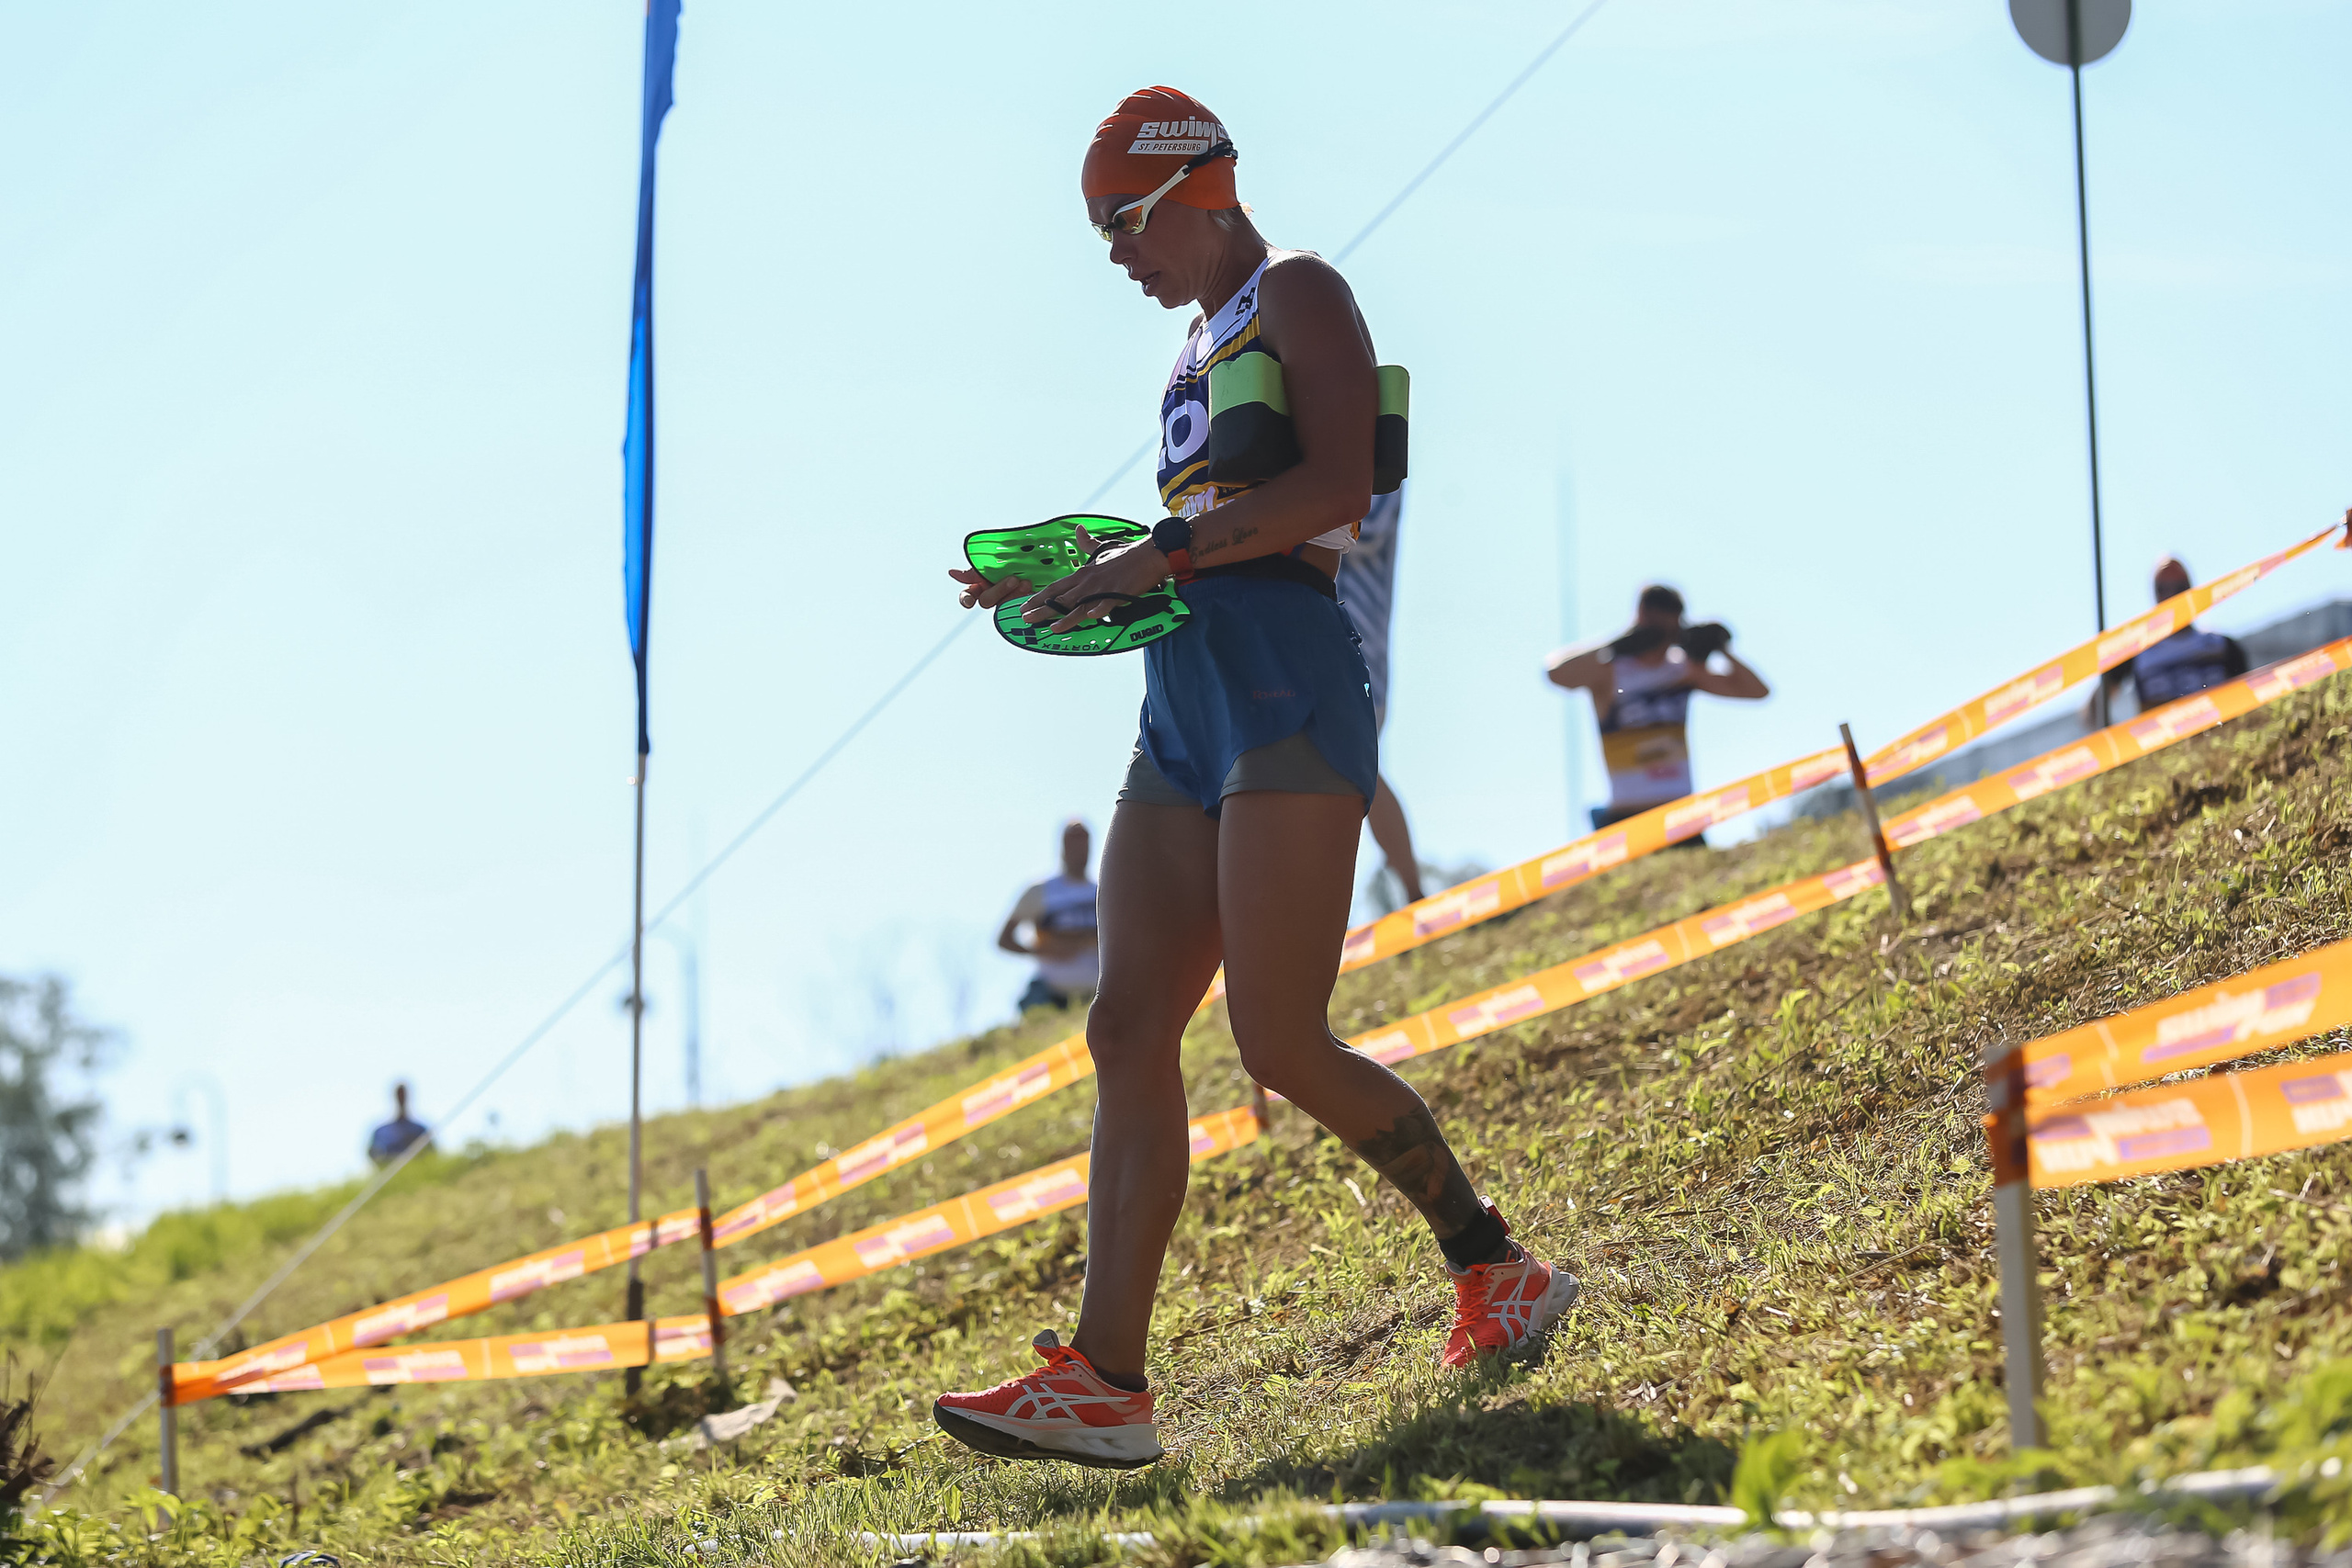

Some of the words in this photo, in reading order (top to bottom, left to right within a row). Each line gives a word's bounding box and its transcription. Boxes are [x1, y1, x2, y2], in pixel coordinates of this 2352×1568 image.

[1138, 142, 1150, 151] ST.
[1152, 142, 1202, 152] PETERSBURG
[1190, 537, 1227, 564] Endless
[1042, 643, 1100, 651] VORTEX
